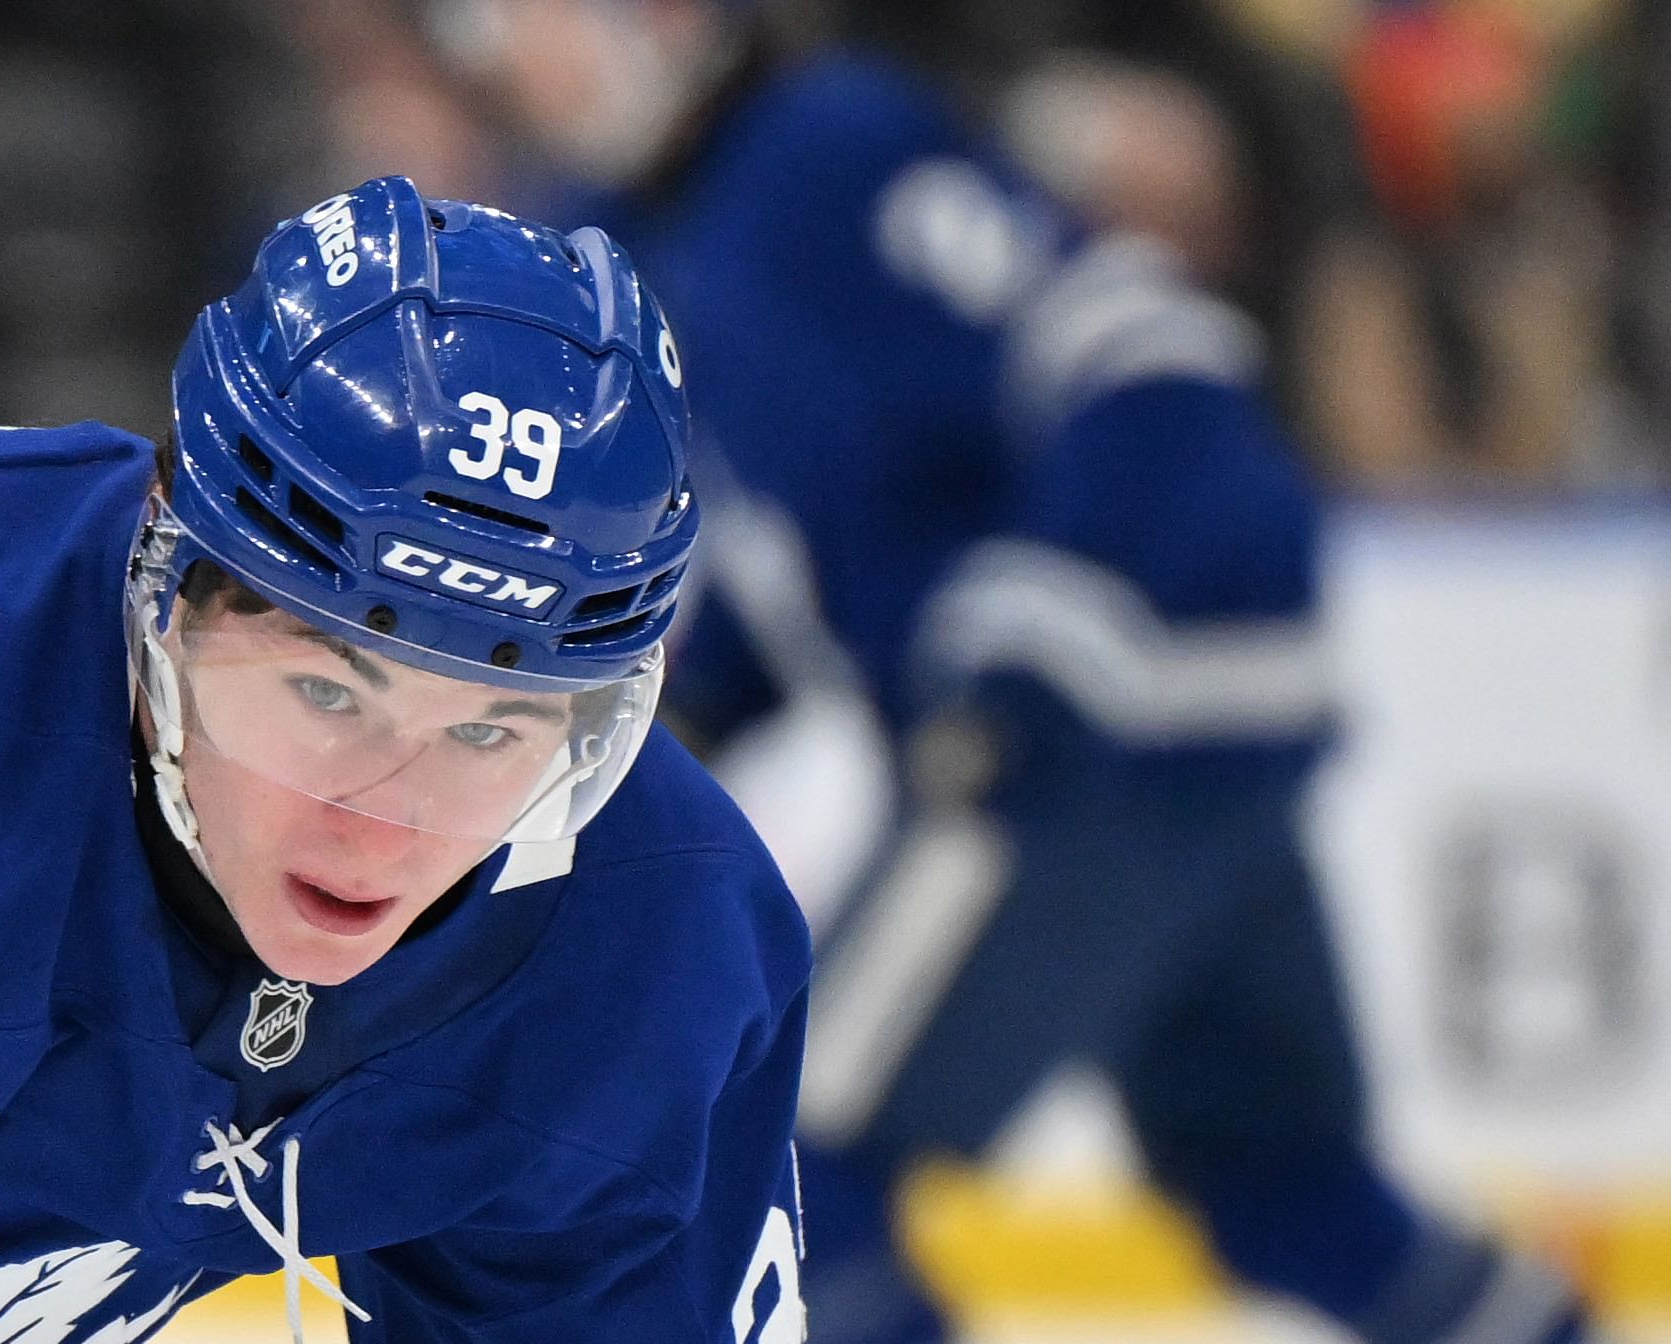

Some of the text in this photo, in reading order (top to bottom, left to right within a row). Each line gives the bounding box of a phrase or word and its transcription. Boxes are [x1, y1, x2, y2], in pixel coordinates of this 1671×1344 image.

[301, 193, 359, 287] OREO
[448, 391, 562, 500] 39
[380, 540, 558, 609] CCM
[253, 1005, 296, 1049] NHL
